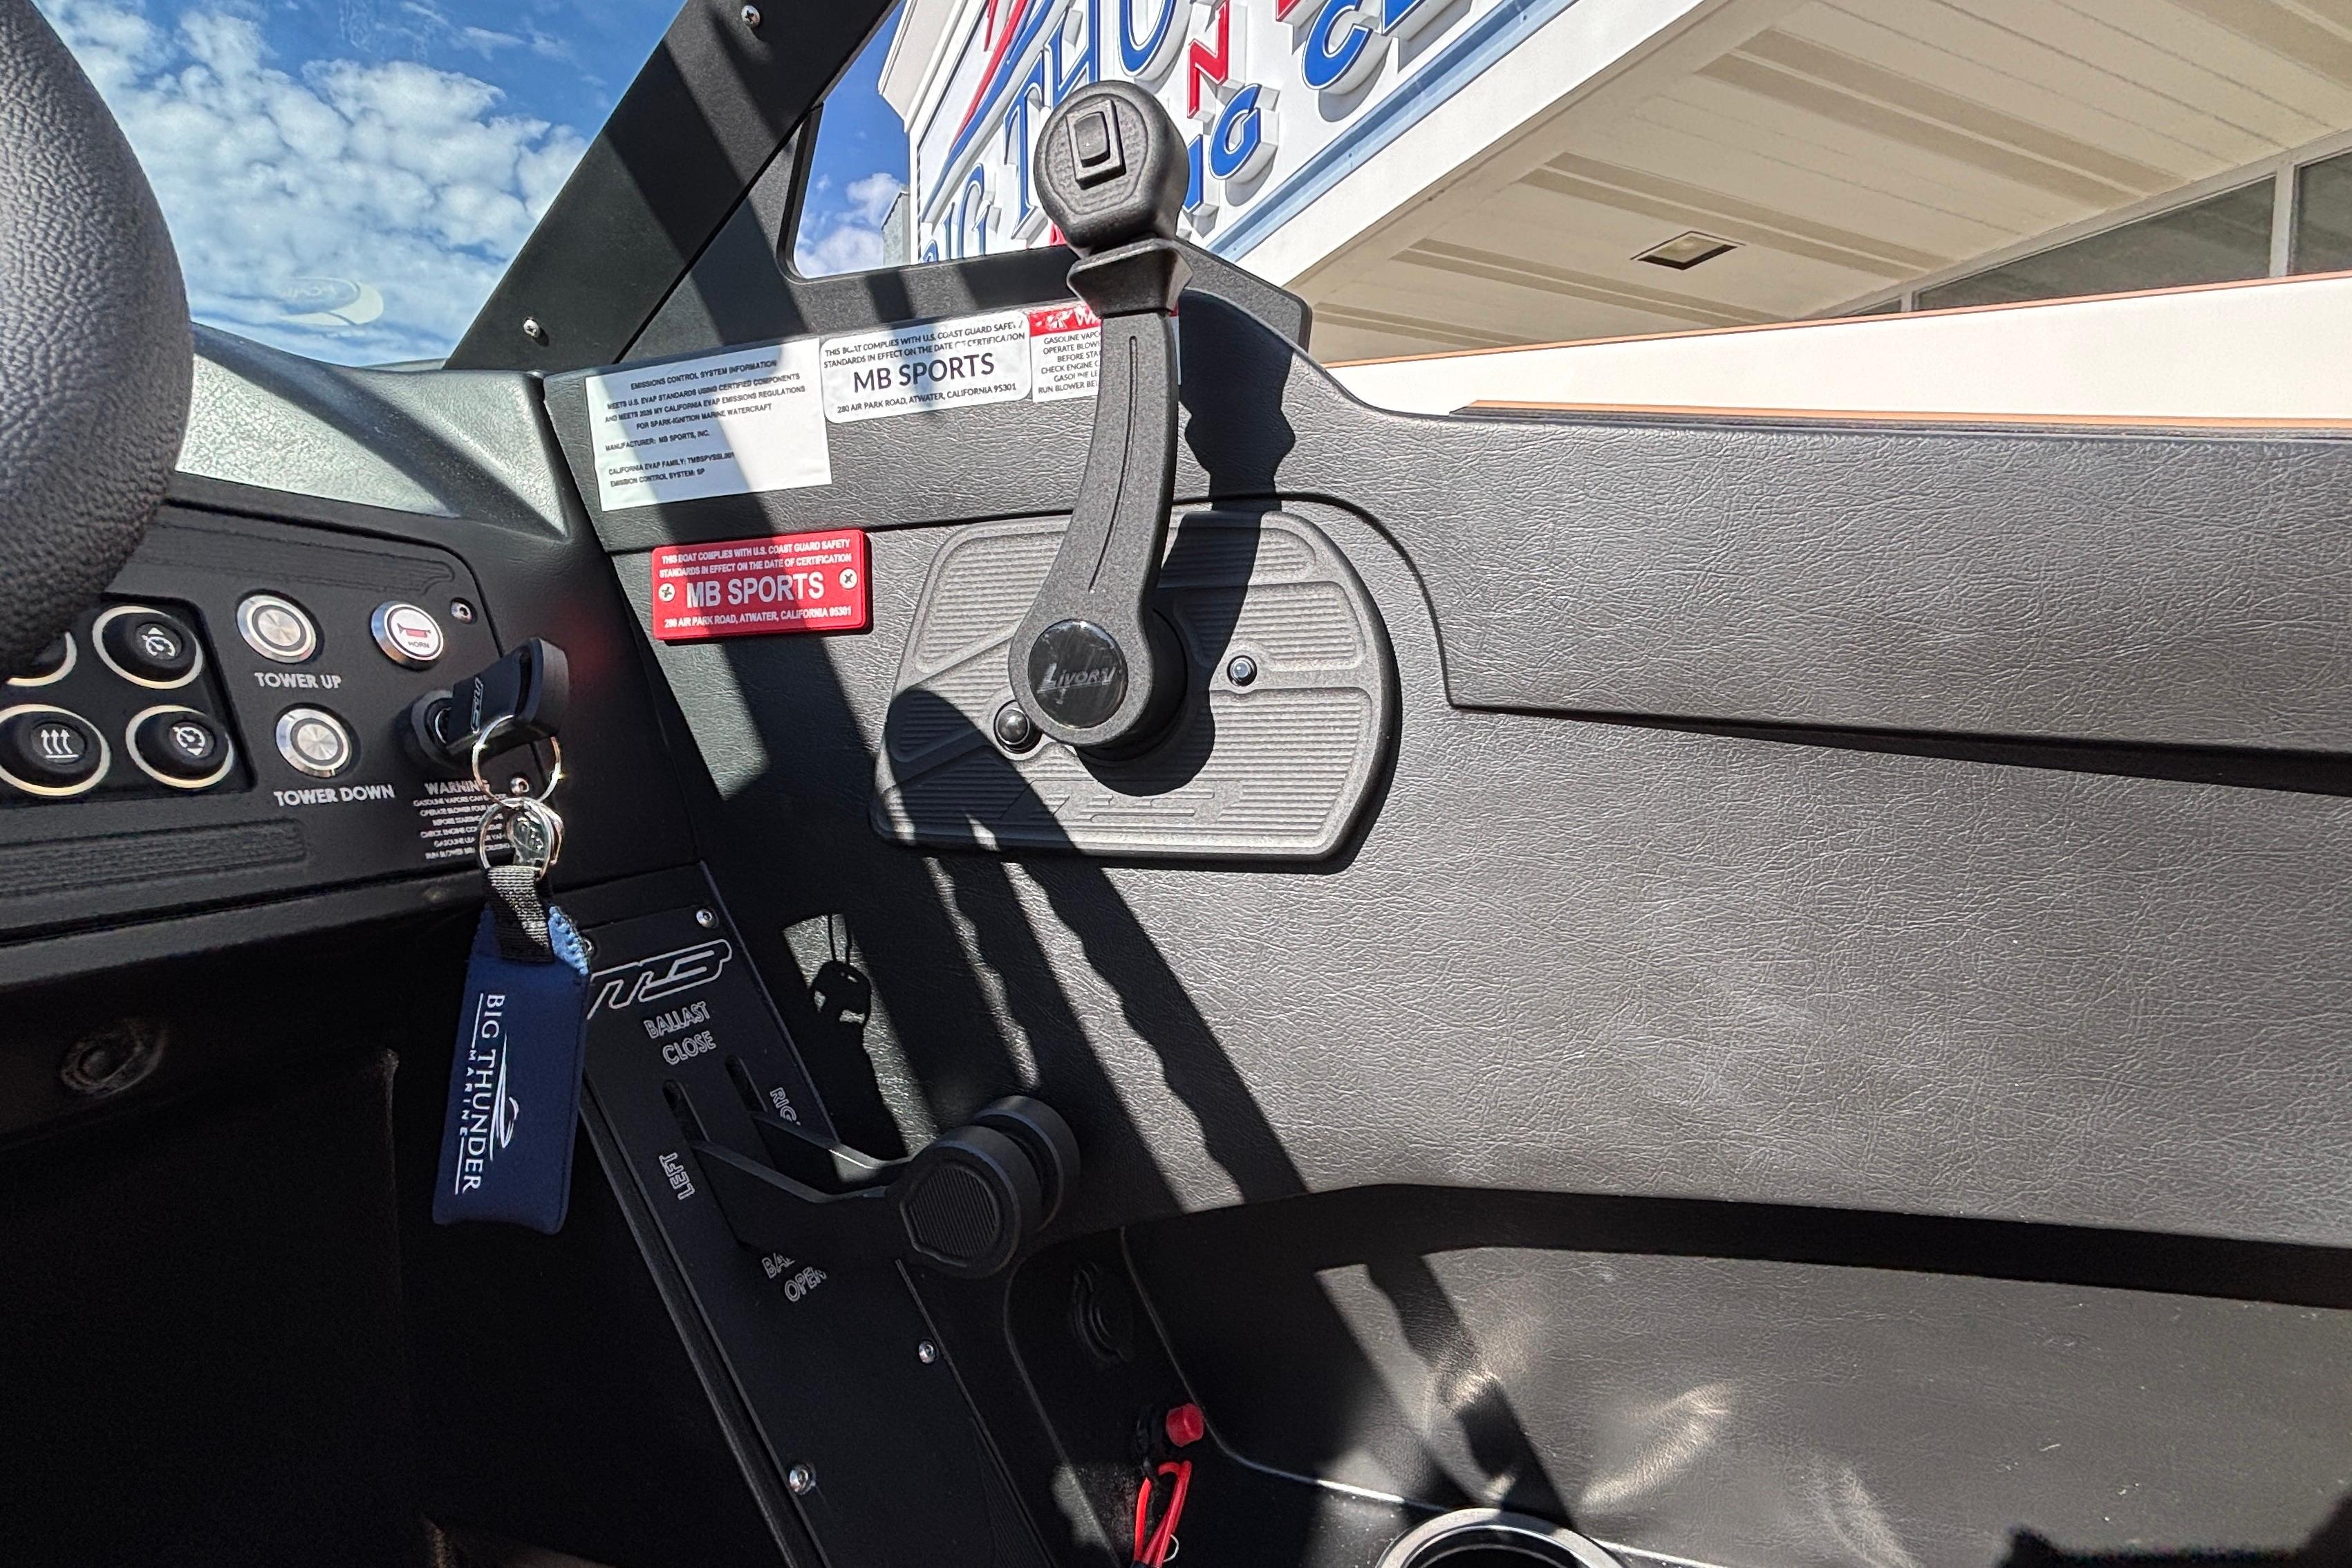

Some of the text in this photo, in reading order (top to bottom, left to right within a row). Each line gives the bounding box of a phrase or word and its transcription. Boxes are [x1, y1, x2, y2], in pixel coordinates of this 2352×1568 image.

[825, 348, 841, 357] THIS
[863, 339, 899, 351] COMPLIES
[900, 335, 921, 345] WITH
[922, 333, 936, 342] U.S.
[937, 329, 963, 339] COAST
[964, 325, 992, 336] GUARD
[1043, 344, 1074, 355] OPERATE
[1044, 334, 1079, 345] GASOLINE
[824, 356, 866, 368] STANDARDS
[877, 350, 902, 360] EFFECT
[904, 348, 916, 356] ON
[918, 345, 933, 354] THE
[934, 343, 953, 352] DATE
[1041, 365, 1065, 374] CHECK
[1066, 362, 1092, 371] ENGINE
[1057, 353, 1084, 362] BEFORE
[631, 360, 777, 390] EMISSIONS CONTROL SYSTEM INFORMATION
[854, 353, 994, 393] MB SPORTS
[607, 400, 627, 409] MEETS
[641, 395, 657, 404] EVAP
[658, 389, 696, 401] STANDARDS
[719, 380, 752, 391] CERTIFIED
[753, 373, 801, 386] COMPONENTS
[837, 383, 1016, 414] 280 AIR PARK ROAD, ATWATER, CALIFORNIA 95301
[1055, 381, 1085, 392] BLOWER
[619, 411, 638, 420] MEETS
[664, 401, 702, 413] CALIFORNIA
[703, 398, 720, 407] EVAP
[722, 392, 756, 404] EMISSIONS
[758, 385, 805, 398] REGULATIONS
[636, 403, 772, 430] FOR SPARK-IGNITION MARINE WATERCRAFT
[605, 438, 656, 451] MANUFACTURER:
[670, 432, 696, 442] SPORTS,
[697, 429, 710, 438] INC.
[609, 465, 644, 475] CALIFORNIA
[644, 462, 661, 470] EVAP
[662, 458, 686, 467] FAMILY:
[639, 472, 668, 483] CONTROL
[669, 469, 696, 479] SYSTEM:
[696, 467, 705, 476] SP
[662, 539, 850, 564] THIS BOAT COMPLIES WITH U.S. COAST GUARD SAFETY
[659, 553, 852, 578] STANDARDS IN EFFECT ON THE DATE OF CERTIFICATION
[687, 571, 825, 608] MB SPORTS
[678, 617, 691, 627] AIR
[692, 615, 714, 626] PARK
[714, 614, 738, 625] ROAD,
[740, 610, 779, 622] ATWATER,
[781, 608, 828, 620] CALIFORNIA
[408, 641, 430, 649] HORN
[254, 672, 342, 690] TOWER UP
[274, 784, 395, 807] TOWER DOWN
[643, 1000, 711, 1039] BALLAST
[662, 1030, 718, 1065] CLOSE
[459, 1049, 477, 1137] MARINE
[463, 993, 505, 1194] BIG THUNDER
[769, 1087, 801, 1126] RIG
[659, 1152, 695, 1200] LEFT
